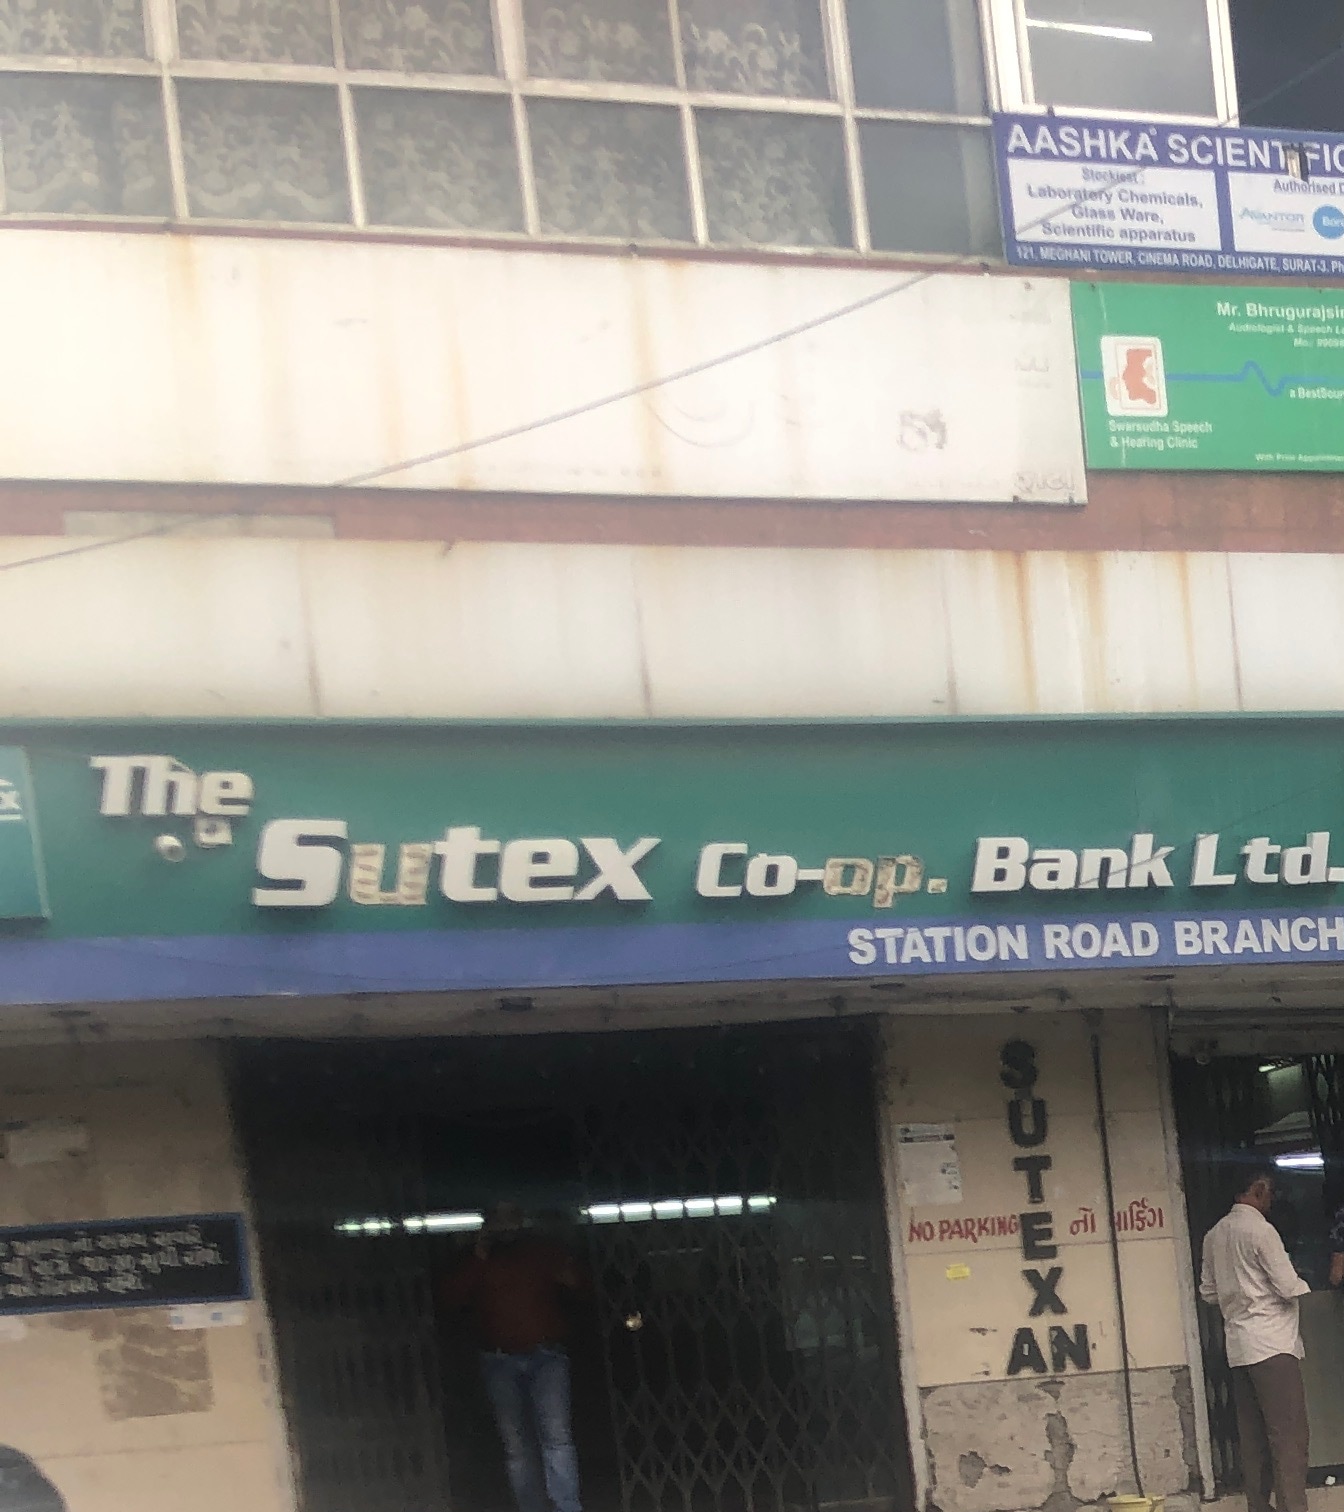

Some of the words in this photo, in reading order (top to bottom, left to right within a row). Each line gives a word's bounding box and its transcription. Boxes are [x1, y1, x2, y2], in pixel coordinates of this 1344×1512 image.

[1008, 124, 1158, 162] AASHKA
[1027, 183, 1114, 205] Laboratory
[1118, 189, 1203, 208] Chemicals,
[1273, 178, 1336, 195] Authorised
[1071, 205, 1116, 221] Glass
[1120, 208, 1165, 225] Ware,
[1041, 223, 1115, 239] Scientific
[1119, 229, 1196, 244] apparatus
[1040, 247, 1091, 263] MEGHANI
[1138, 252, 1179, 267] CINEMA
[1216, 301, 1241, 317] Mr.
[1172, 420, 1214, 434] Speech
[1166, 437, 1198, 449] Clinic
[90, 753, 254, 817] The
[250, 818, 662, 907] Sutex
[694, 841, 950, 911] Co-op.
[969, 832, 1175, 894] Bank
[848, 923, 1031, 968] STATION
[1043, 922, 1161, 962] ROAD
[908, 1219, 936, 1243] NO
[939, 1213, 1020, 1244] PARKING
